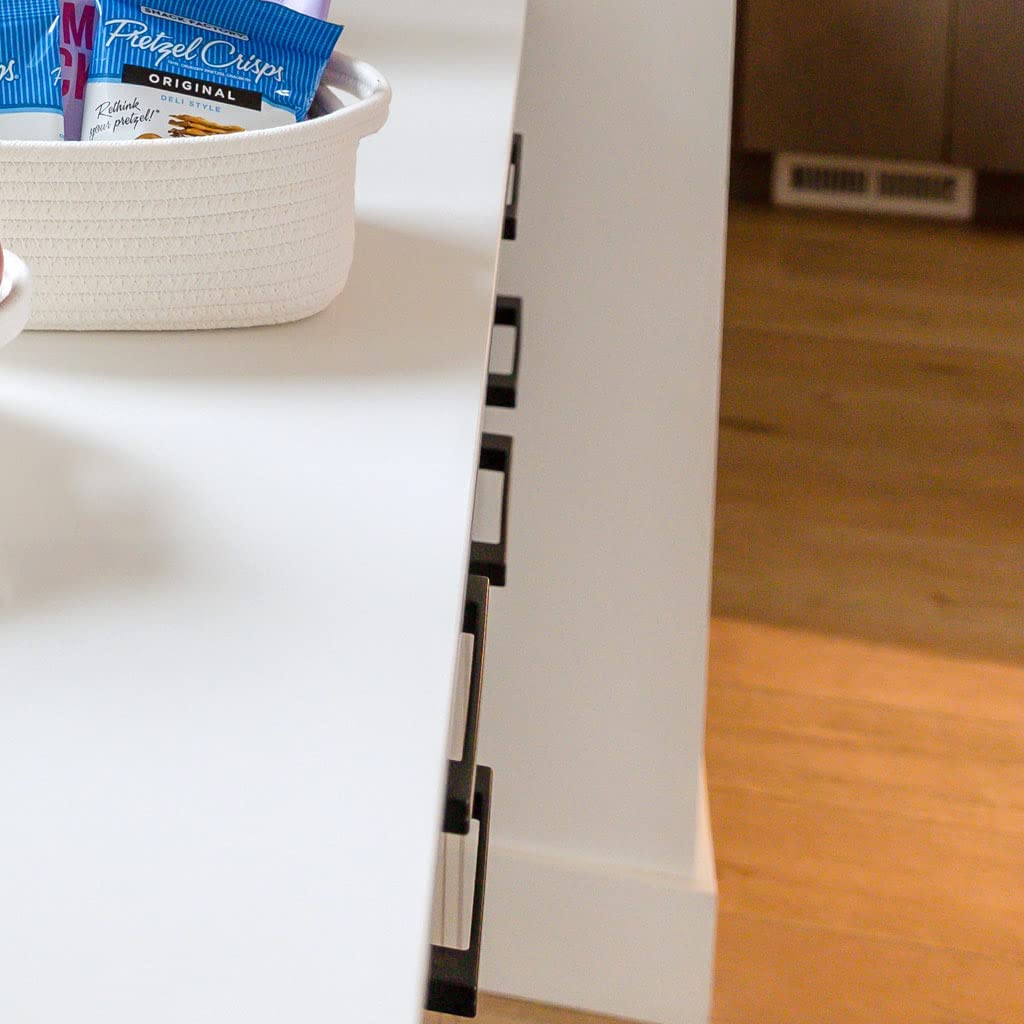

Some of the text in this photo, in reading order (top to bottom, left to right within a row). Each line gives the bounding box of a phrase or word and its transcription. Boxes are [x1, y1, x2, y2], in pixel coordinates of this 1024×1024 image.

[105, 18, 203, 67] Pretzel
[200, 40, 285, 84] Crisps
[148, 73, 236, 101] ORIGINAL
[95, 97, 141, 119] Rethink
[160, 94, 222, 113] DELI STYLE
